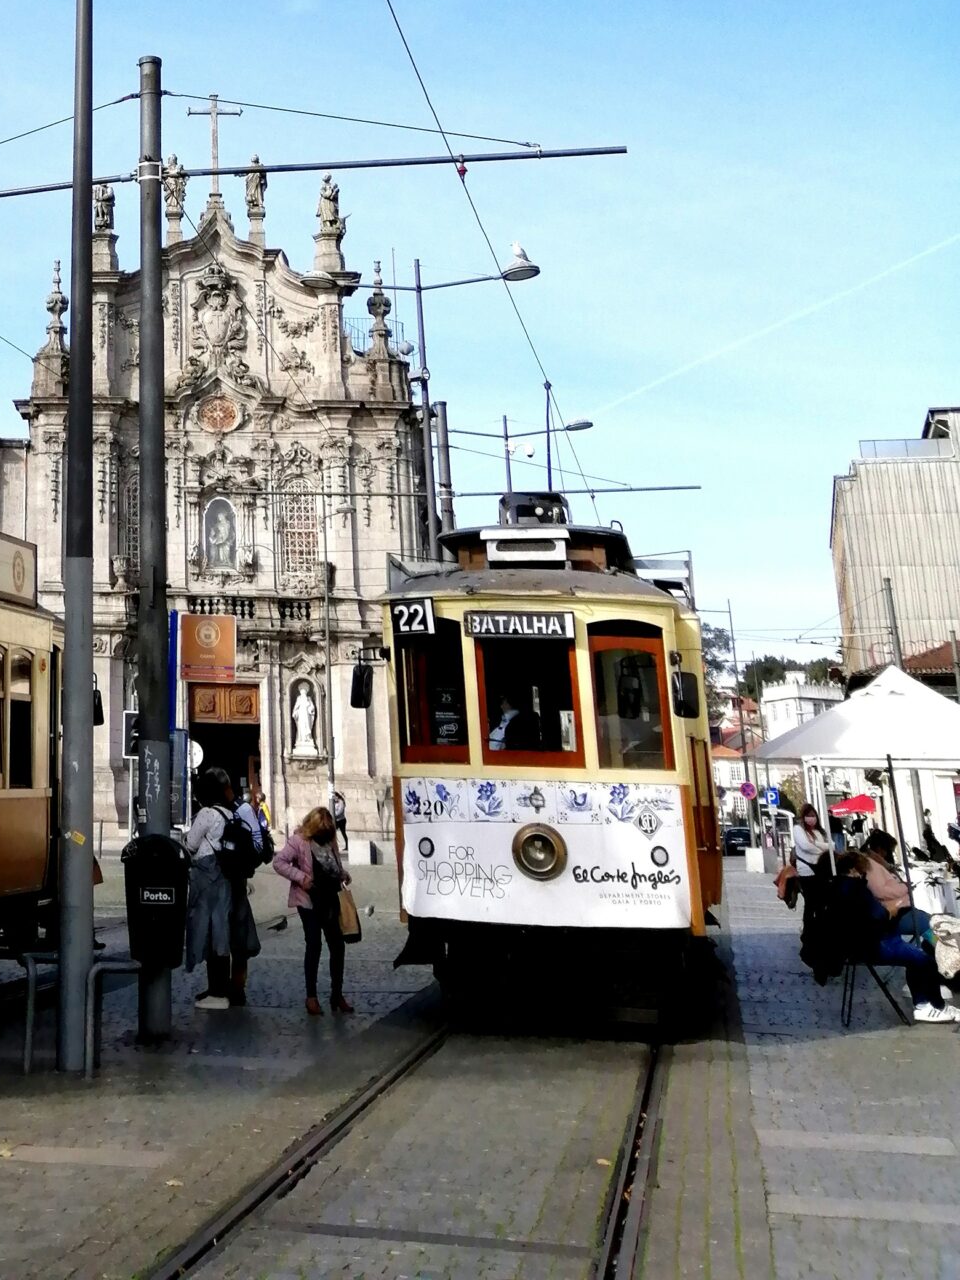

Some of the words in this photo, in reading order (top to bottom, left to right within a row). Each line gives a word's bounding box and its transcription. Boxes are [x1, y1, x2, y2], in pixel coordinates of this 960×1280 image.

[393, 604, 425, 632] 22
[467, 614, 563, 635] BATALHA
[448, 845, 475, 861] FOR
[417, 859, 513, 885] SHOPPING
[590, 865, 629, 884] Corte
[143, 890, 171, 901] Porto.
[426, 874, 506, 899] LOVERS
